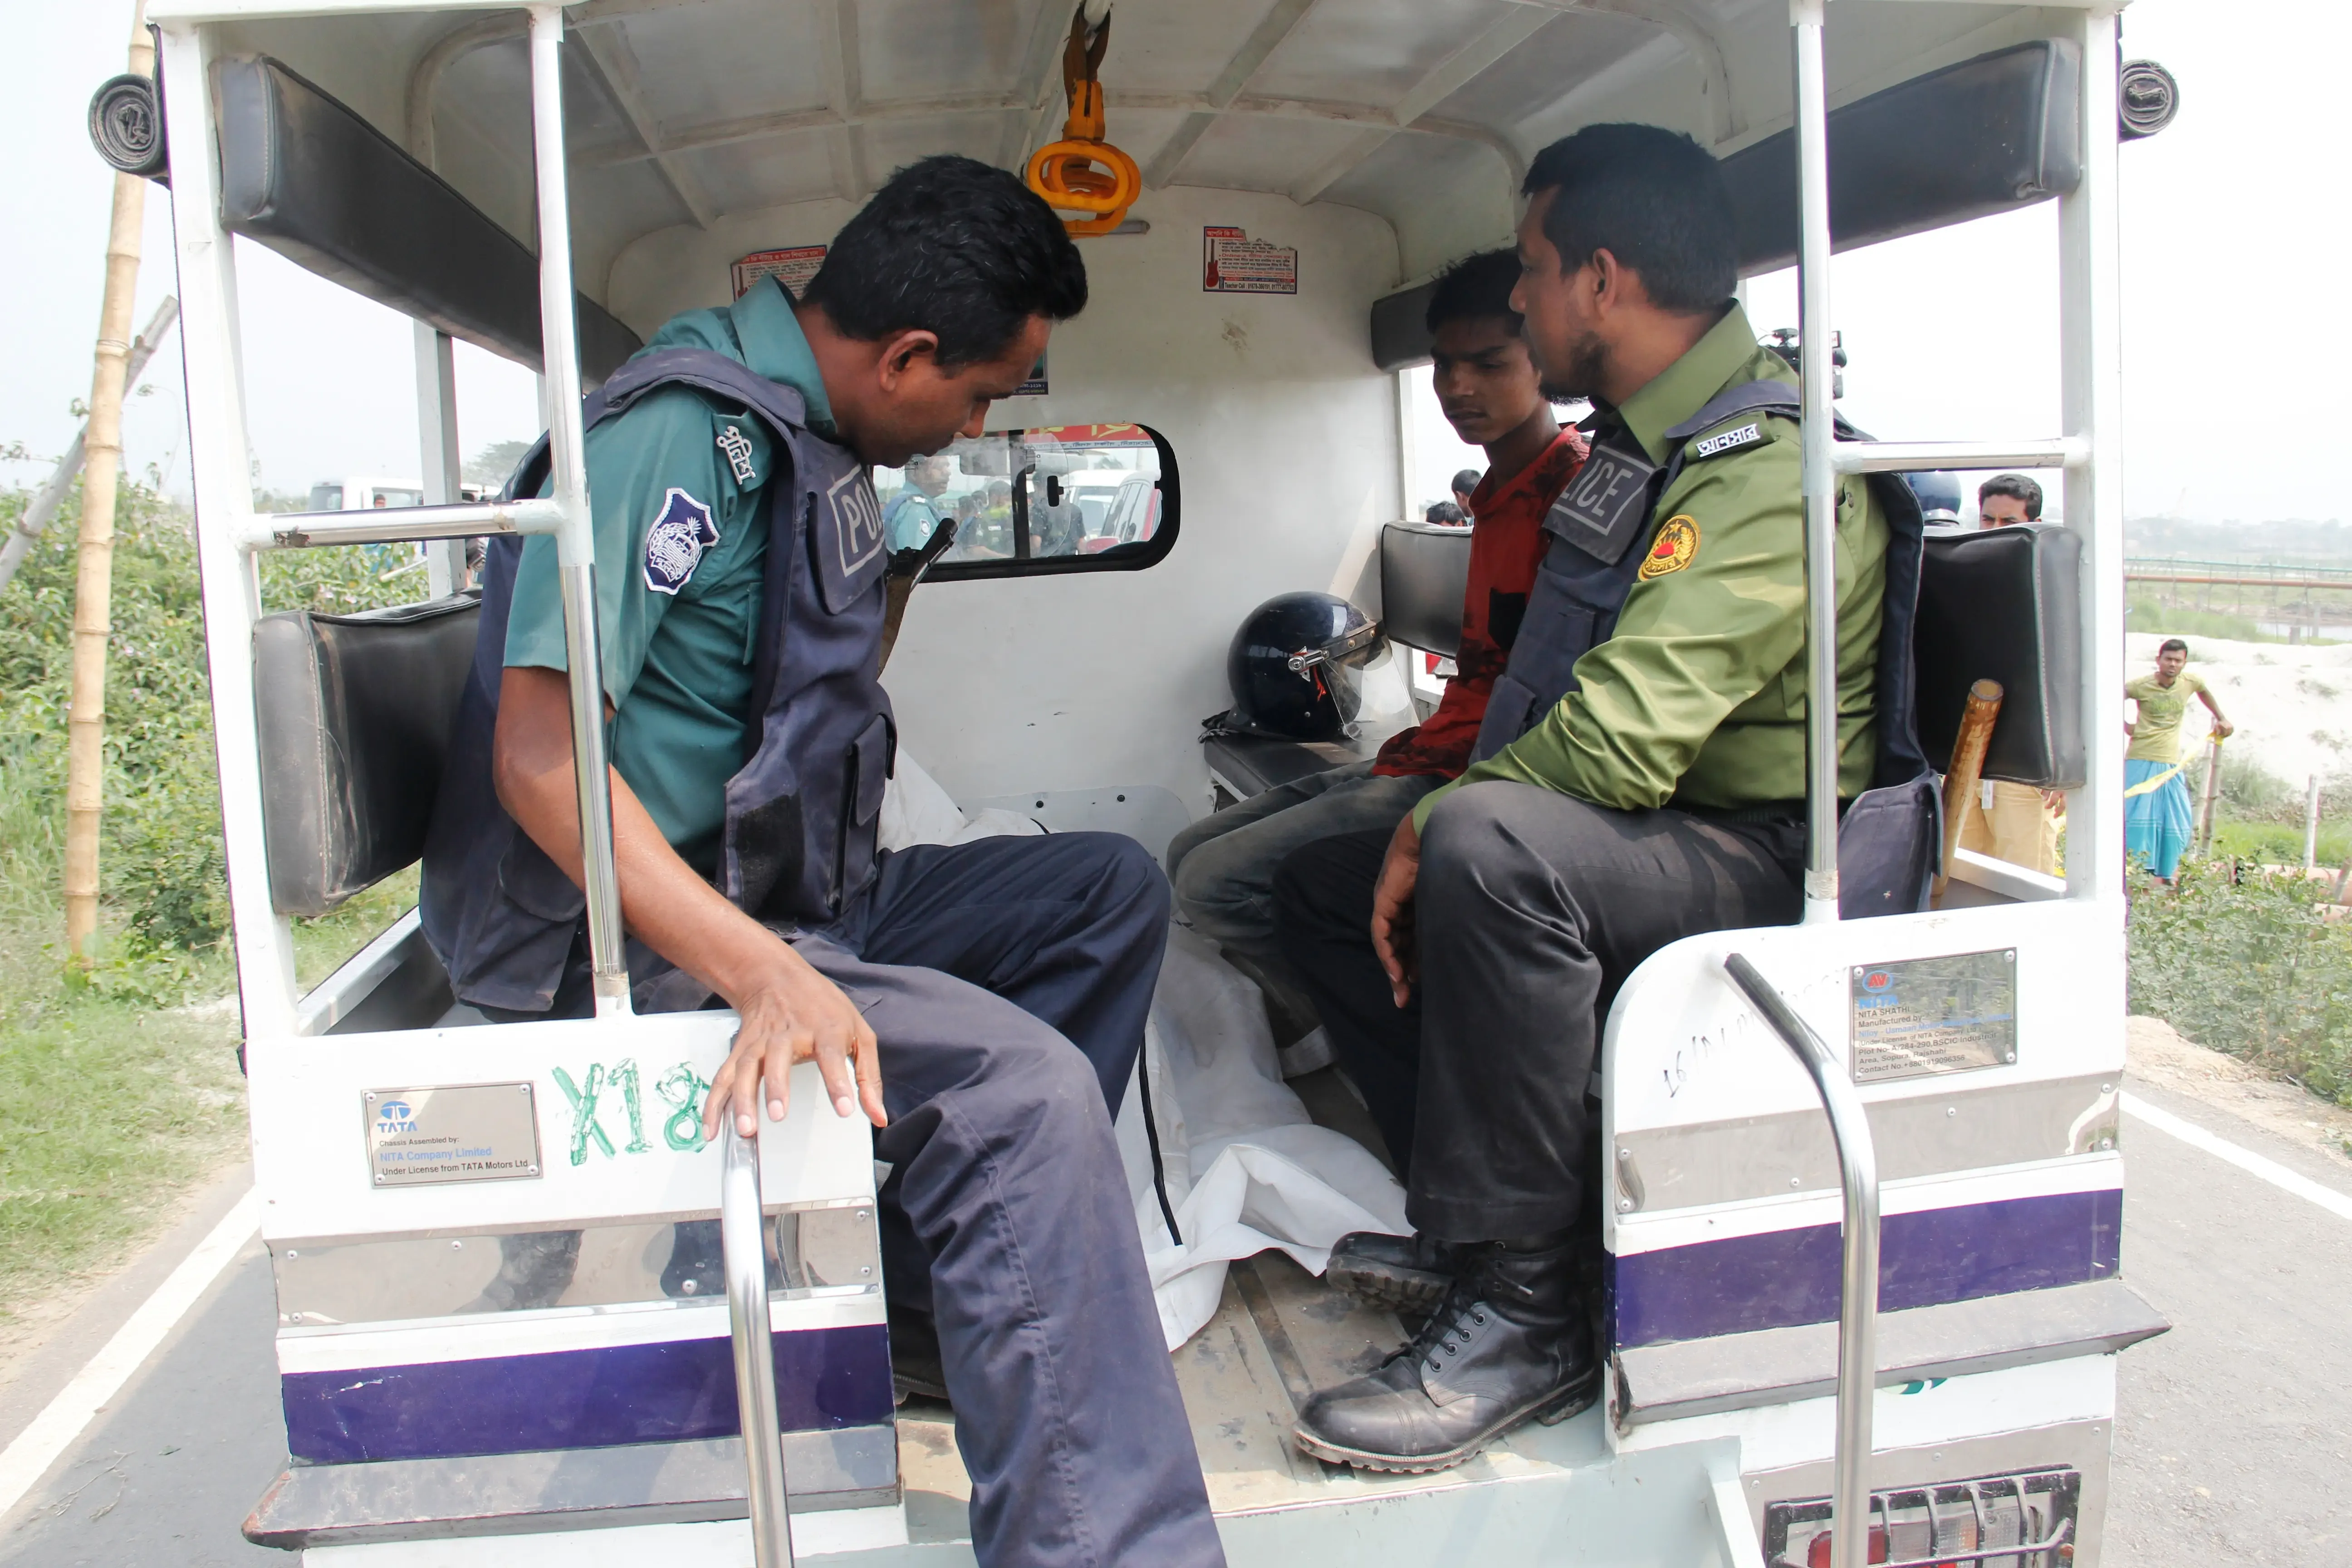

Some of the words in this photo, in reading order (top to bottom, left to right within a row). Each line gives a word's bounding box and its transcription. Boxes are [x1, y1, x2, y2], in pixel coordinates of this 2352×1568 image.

[1695, 423, 1761, 458] আনসার
[716, 425, 756, 485] পুলিশ
[1879, 1006, 1910, 1016] SHATHI
[1858, 1014, 1911, 1028] Manufactured
[1882, 1036, 1907, 1044] License
[1935, 1028, 1964, 1037] Company
[1858, 1048, 1874, 1056] Plot
[1913, 1048, 1947, 1058] Rajshahi
[1859, 1065, 1888, 1074] Contact
[377, 1121, 418, 1133] TATA
[379, 1139, 407, 1147] Chassis
[408, 1137, 447, 1145] Assembled
[449, 1136, 460, 1144] by:
[380, 1151, 404, 1162] NITA
[407, 1149, 453, 1161] Company
[456, 1146, 492, 1158] Limited
[382, 1166, 406, 1176] Under
[408, 1164, 439, 1174] License
[441, 1164, 460, 1172] from
[461, 1162, 483, 1171] TATA
[485, 1161, 513, 1170] Motors
[515, 1159, 528, 1168] Ltd
